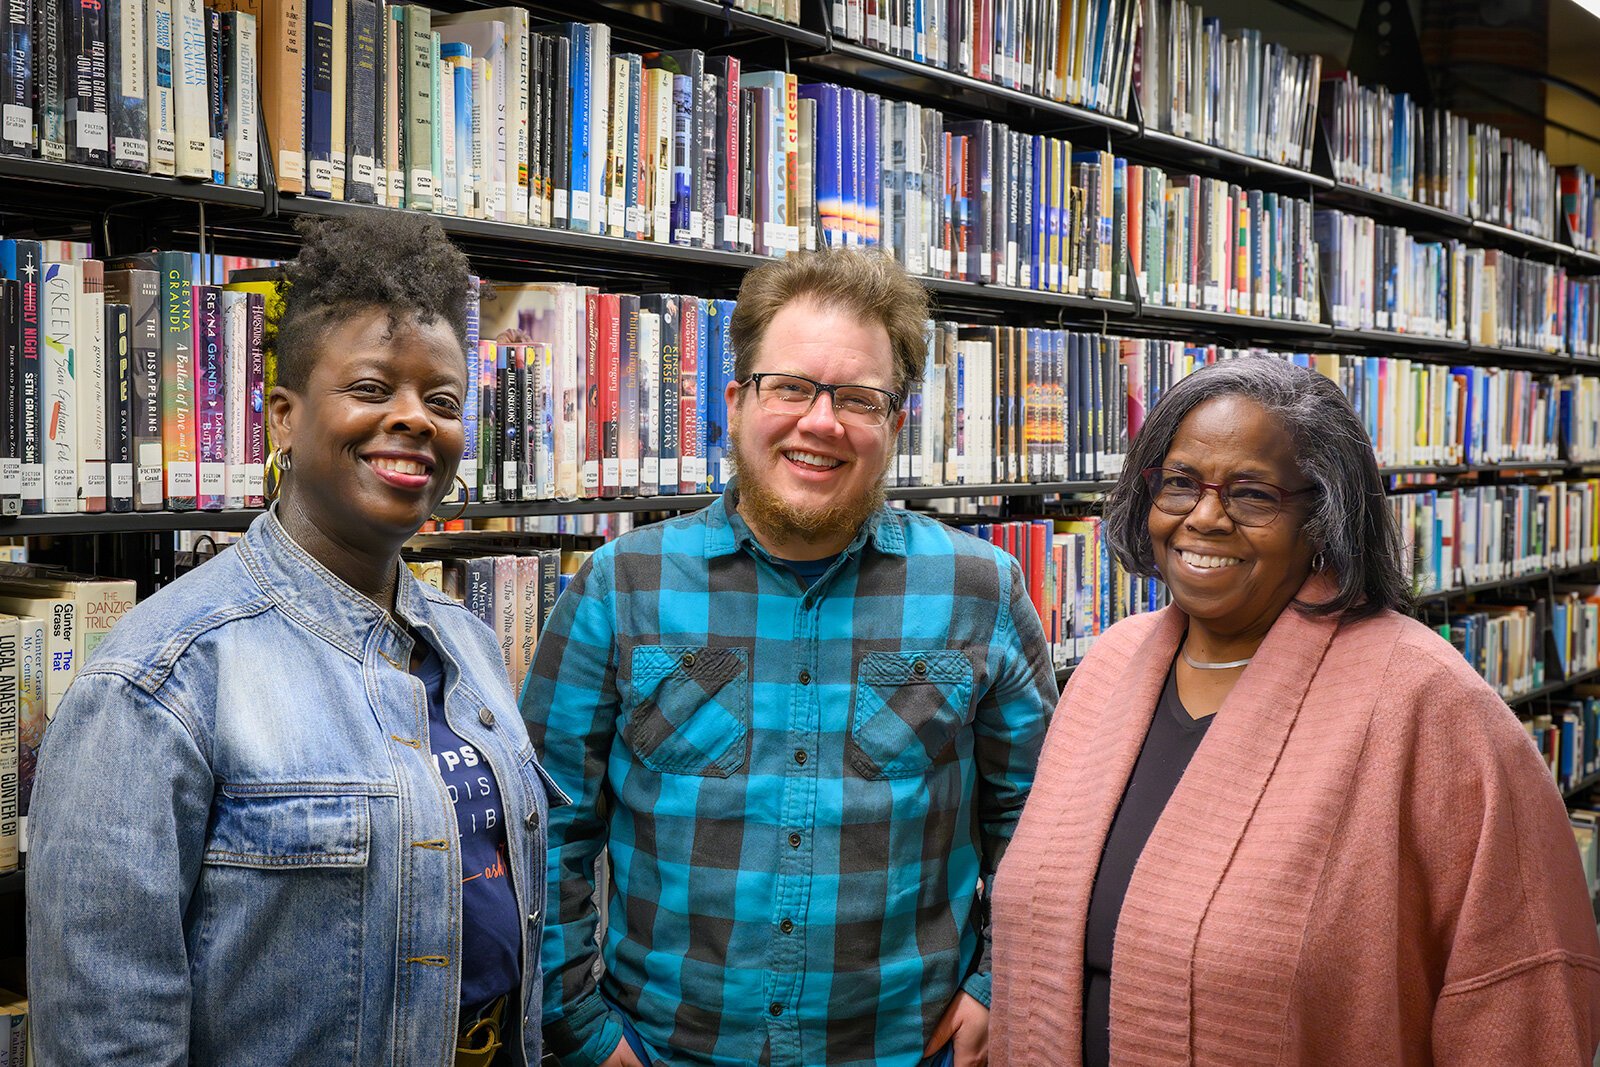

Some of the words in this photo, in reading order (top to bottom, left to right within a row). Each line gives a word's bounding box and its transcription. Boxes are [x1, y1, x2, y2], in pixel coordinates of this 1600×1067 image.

[161, 11, 170, 48] HEATHER
[16, 50, 24, 99] PHANTOM
[77, 55, 92, 73] JON
[92, 41, 104, 78] HEATHER
[183, 31, 194, 85] GRAHAM
[193, 33, 206, 86] HEATHER
[240, 43, 250, 85] HEATHER
[520, 34, 528, 111] LIBERTIE
[78, 75, 92, 97] LAND
[789, 82, 797, 121] LESS
[241, 88, 250, 125] GRAHAM
[583, 110, 588, 123] WE
[122, 141, 146, 150] FICTION
[157, 138, 174, 146] FICTION
[695, 118, 703, 147] Lucy
[788, 128, 797, 142] IS
[124, 149, 144, 157] Graham
[788, 151, 797, 190] LOST
[1010, 180, 1018, 224] GRISHAM
[24, 282, 37, 325] UNHOLY
[50, 277, 71, 346] GREEN
[169, 269, 181, 333] GRANDE
[181, 279, 191, 332] REYNA
[206, 292, 217, 338] REYNA
[588, 299, 597, 338] Constant
[24, 327, 37, 360] NIGHT
[147, 319, 156, 338] THE
[176, 342, 189, 352] A
[609, 316, 619, 353] Philippa
[626, 311, 639, 348] Philippa
[722, 315, 731, 377] GREGORY
[92, 344, 103, 379] gossip
[175, 354, 189, 392] Ballad
[207, 343, 218, 396] GRANDE
[588, 339, 598, 376] Princess
[625, 351, 638, 389] Gregory
[663, 345, 672, 383] CURSE
[1033, 335, 1041, 376] GRISHAM
[1055, 337, 1063, 377] GRISHAM
[25, 372, 34, 395] SETH
[147, 351, 158, 433] DISAPPEARING
[506, 367, 515, 387] JILL
[608, 357, 619, 392] Gregory
[176, 394, 189, 407] of
[176, 407, 189, 431] Love
[506, 387, 515, 424] GREGORY
[525, 386, 534, 422] GREGORY
[610, 400, 618, 431] DARK
[663, 388, 672, 449] GREGORY
[120, 409, 128, 441] SARA
[214, 411, 223, 460] DANCING
[252, 422, 262, 457] AMANDA
[543, 562, 556, 579] THE
[86, 601, 133, 615] DANZIG
[103, 592, 118, 601] THE
[477, 581, 487, 620] WHITE
[503, 579, 515, 601] The
[524, 580, 535, 601] The
[543, 581, 556, 603] WISE
[53, 604, 64, 637] Grass
[63, 603, 74, 642] Günter
[503, 601, 514, 633] White
[523, 602, 535, 634] White
[0, 634, 16, 672] LOCAL
[22, 636, 33, 652] My
[35, 628, 43, 667] Günter
[53, 652, 63, 672] Rat
[62, 649, 73, 671] The
[501, 634, 513, 666] Queen
[521, 635, 534, 666] Queen
[24, 655, 33, 695] Century
[35, 671, 43, 701] Grass
[0, 675, 16, 753] ANAESTHETIC
[1, 772, 17, 823] GUNTER
